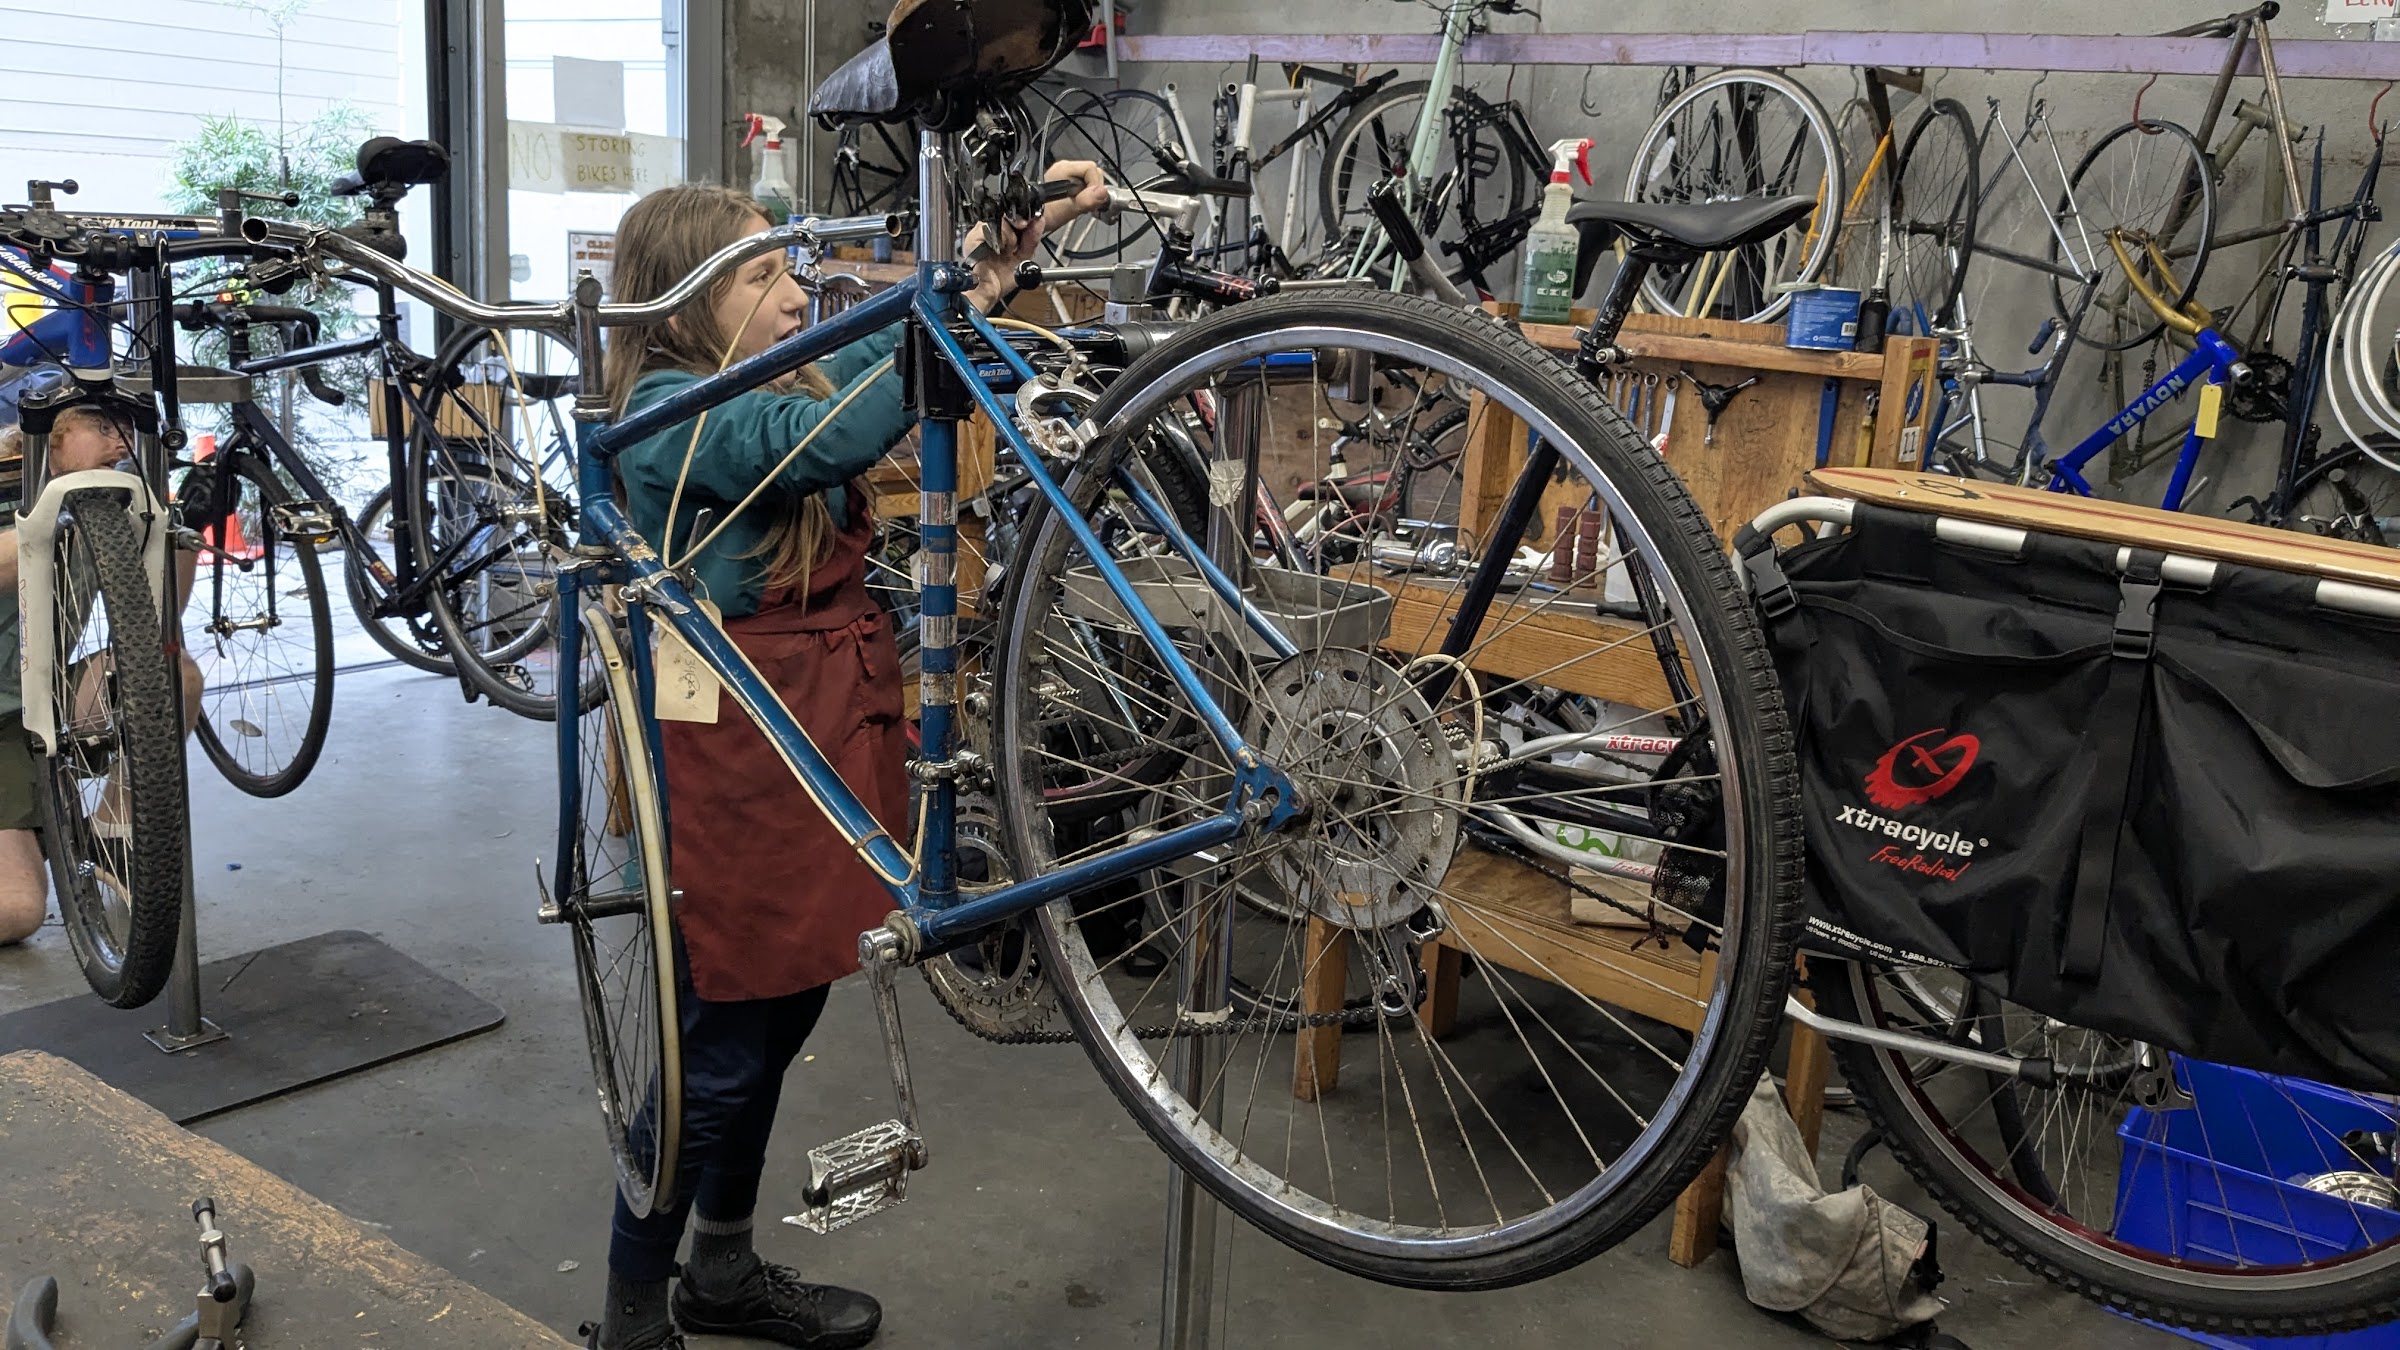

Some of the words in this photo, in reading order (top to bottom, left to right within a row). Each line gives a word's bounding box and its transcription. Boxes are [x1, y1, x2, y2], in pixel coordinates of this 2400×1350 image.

[511, 132, 552, 181] NO
[576, 135, 646, 158] STORING
[576, 164, 617, 184] BIKES
[623, 167, 649, 183] HERE
[121, 218, 159, 229] Tool
[2108, 375, 2185, 435] NOVARA
[1869, 845, 1971, 881] FreeRadical
[1808, 915, 1893, 954] www.xtracycle.com
